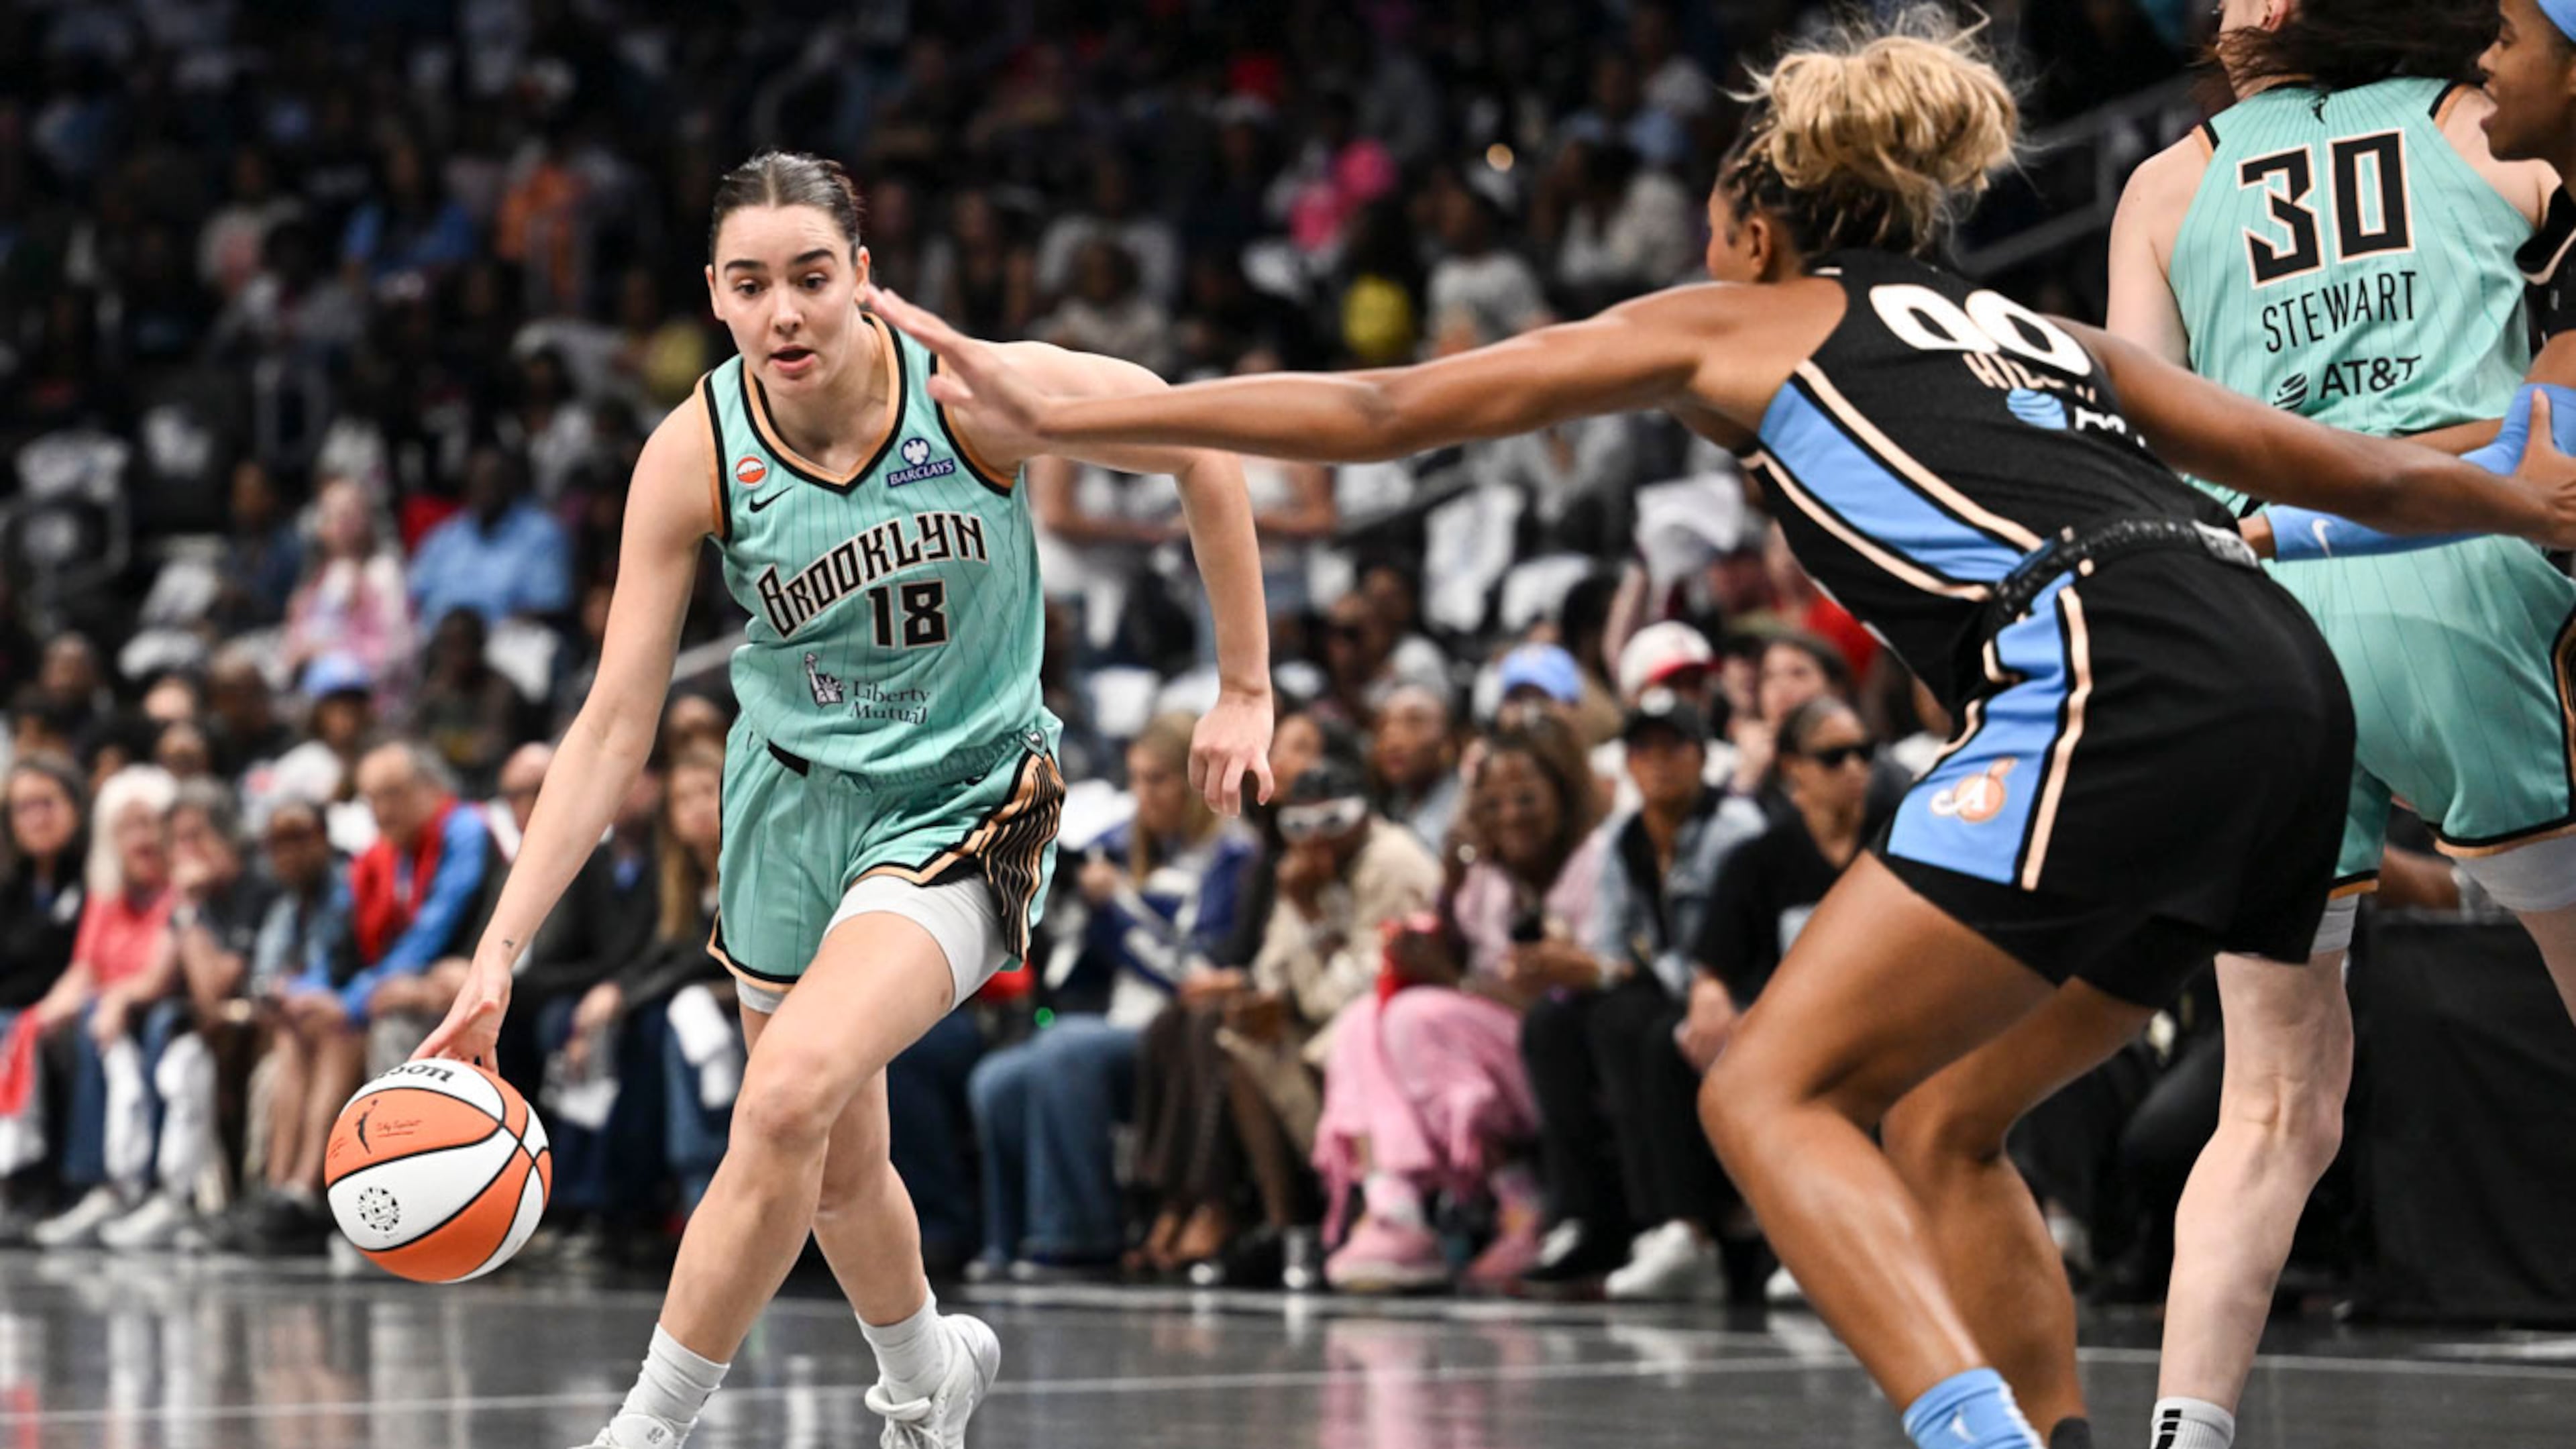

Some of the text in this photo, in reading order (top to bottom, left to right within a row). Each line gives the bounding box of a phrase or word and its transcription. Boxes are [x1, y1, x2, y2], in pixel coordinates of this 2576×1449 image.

[2238, 129, 2414, 288] 30
[1869, 284, 2092, 376] 00
[2262, 272, 2417, 353] STEWART
[2320, 356, 2422, 400] AT&T
[889, 460, 953, 486] BARCLAYS
[757, 511, 988, 639] BROOKLYN
[867, 580, 950, 649] 18
[849, 700, 927, 725] Mutual
[853, 680, 930, 703] Liberty
